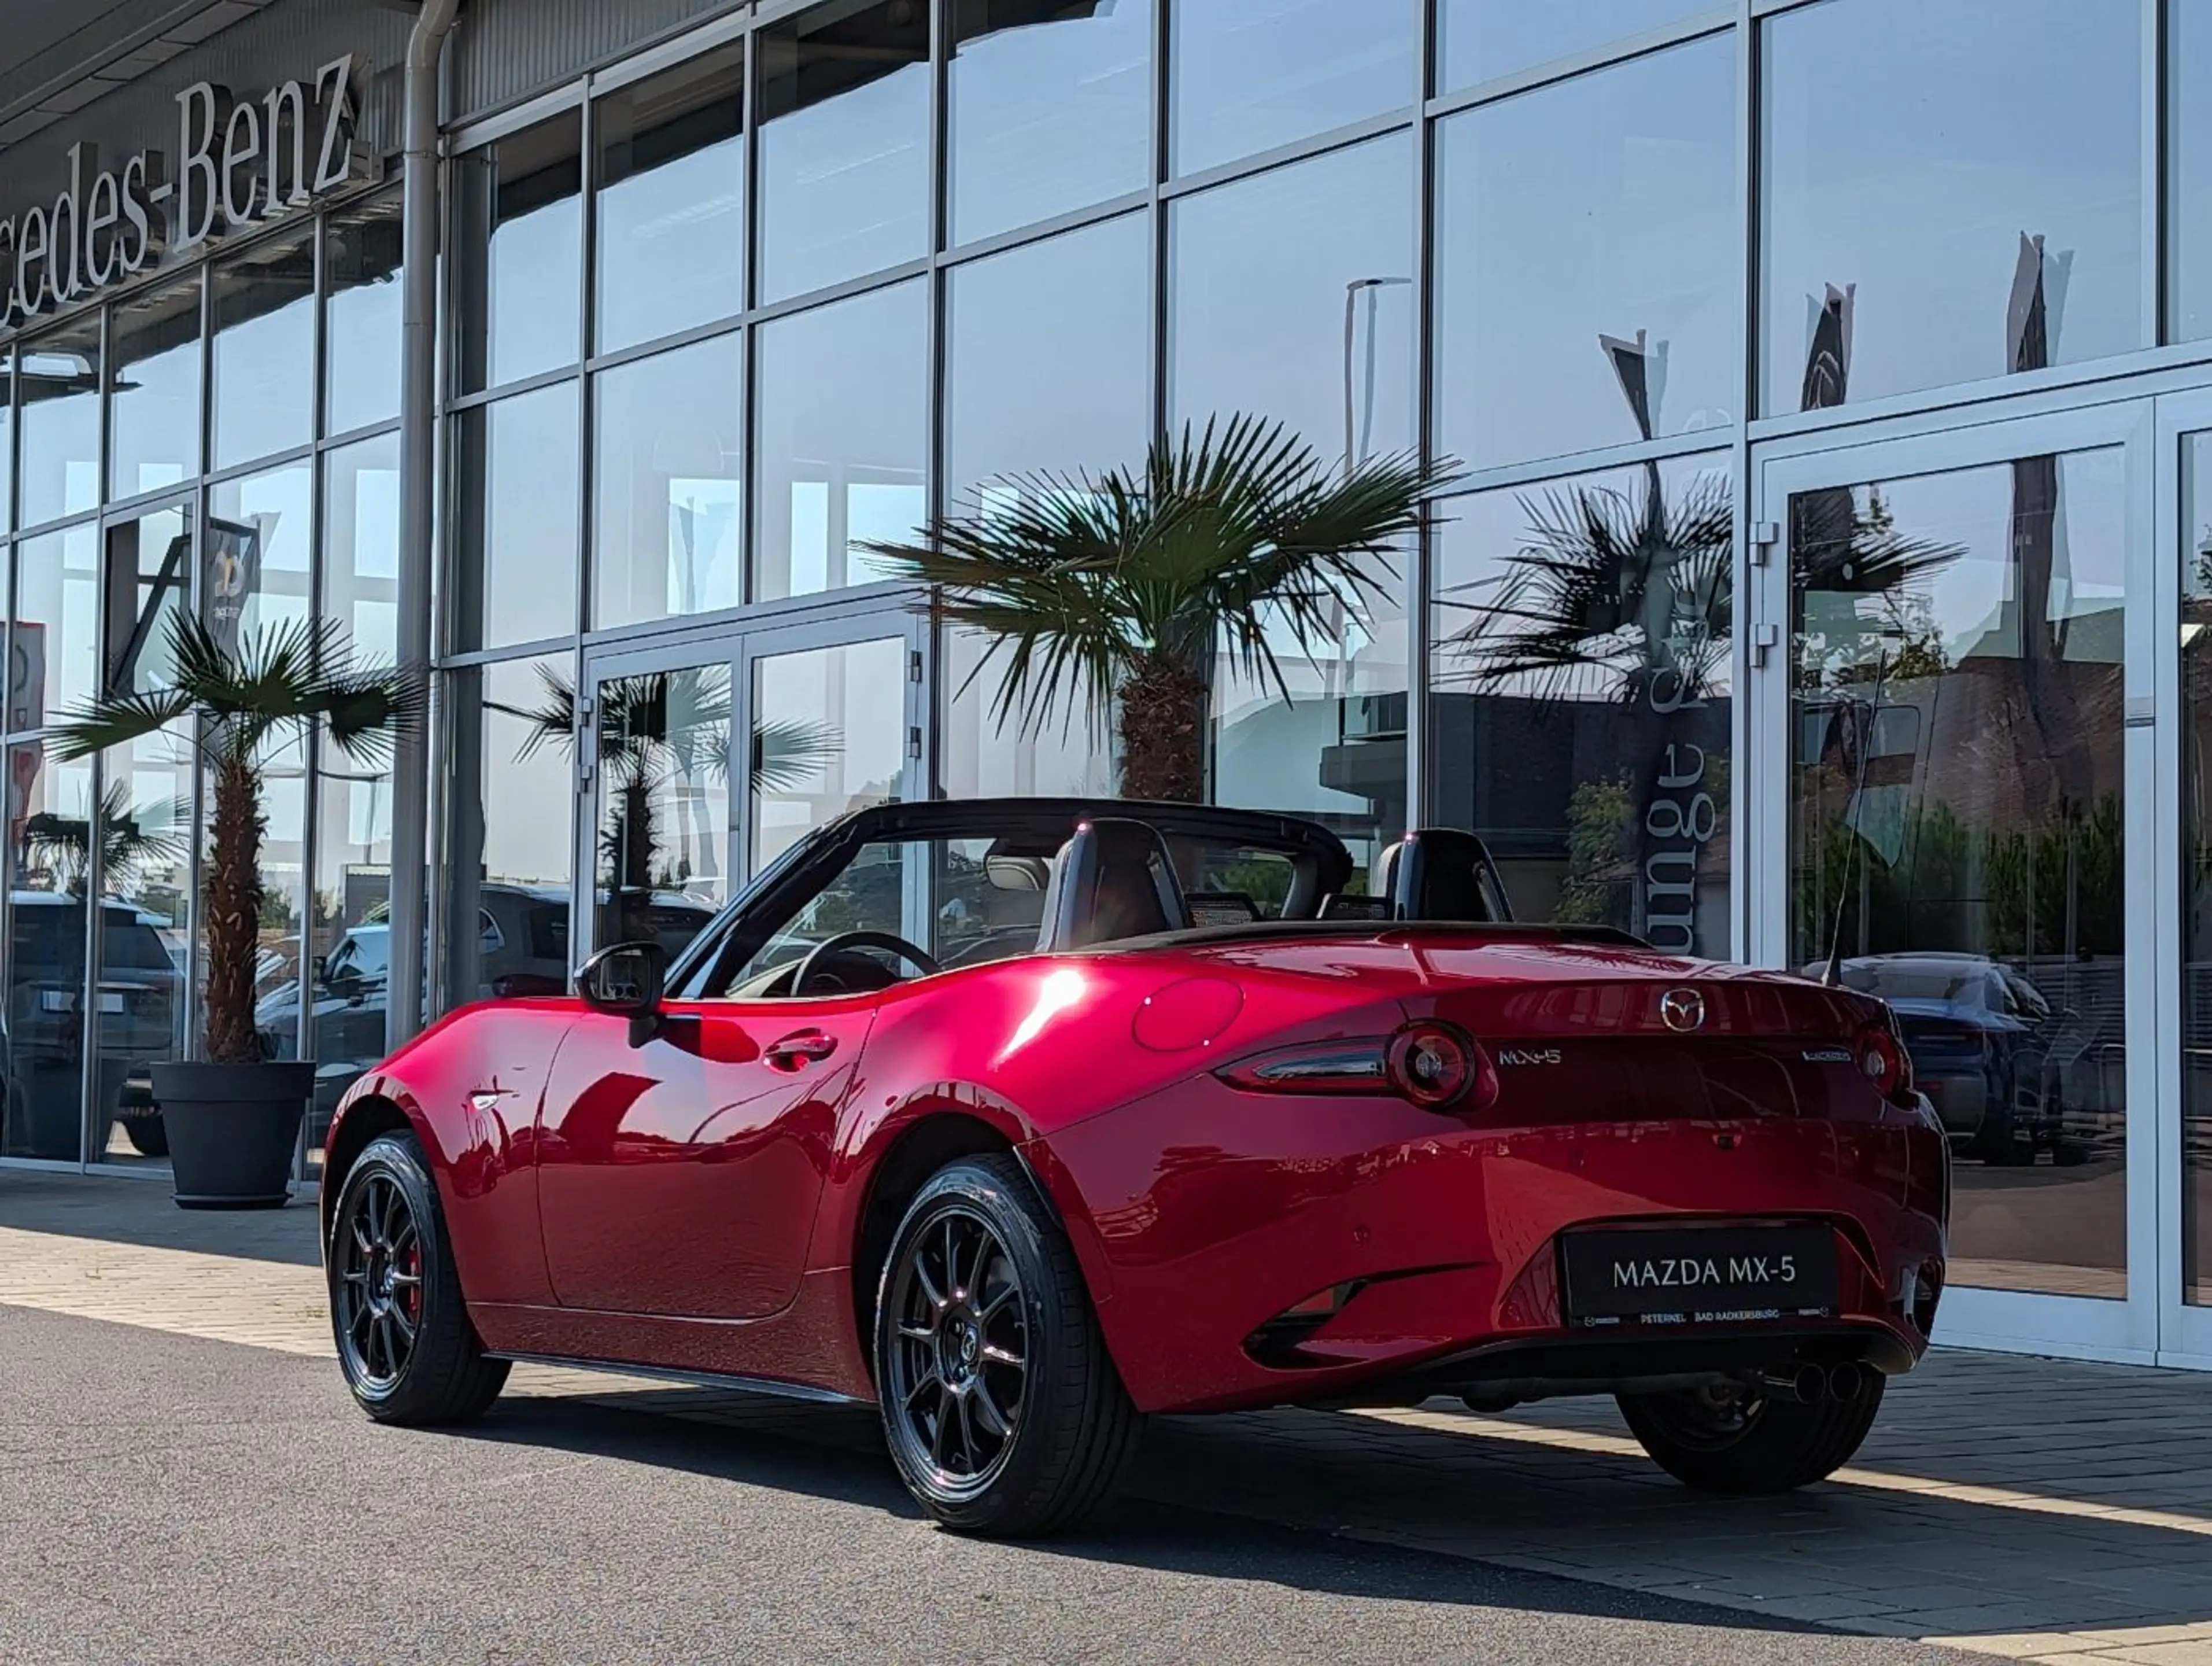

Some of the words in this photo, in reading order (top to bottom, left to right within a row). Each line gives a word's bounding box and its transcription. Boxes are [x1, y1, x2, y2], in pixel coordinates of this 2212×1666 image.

[1499, 1049, 1561, 1065] MX-5
[1613, 1259, 1720, 1287] MAZDA
[1730, 1255, 1797, 1284] MX-5
[1695, 1311, 1714, 1322] BAD
